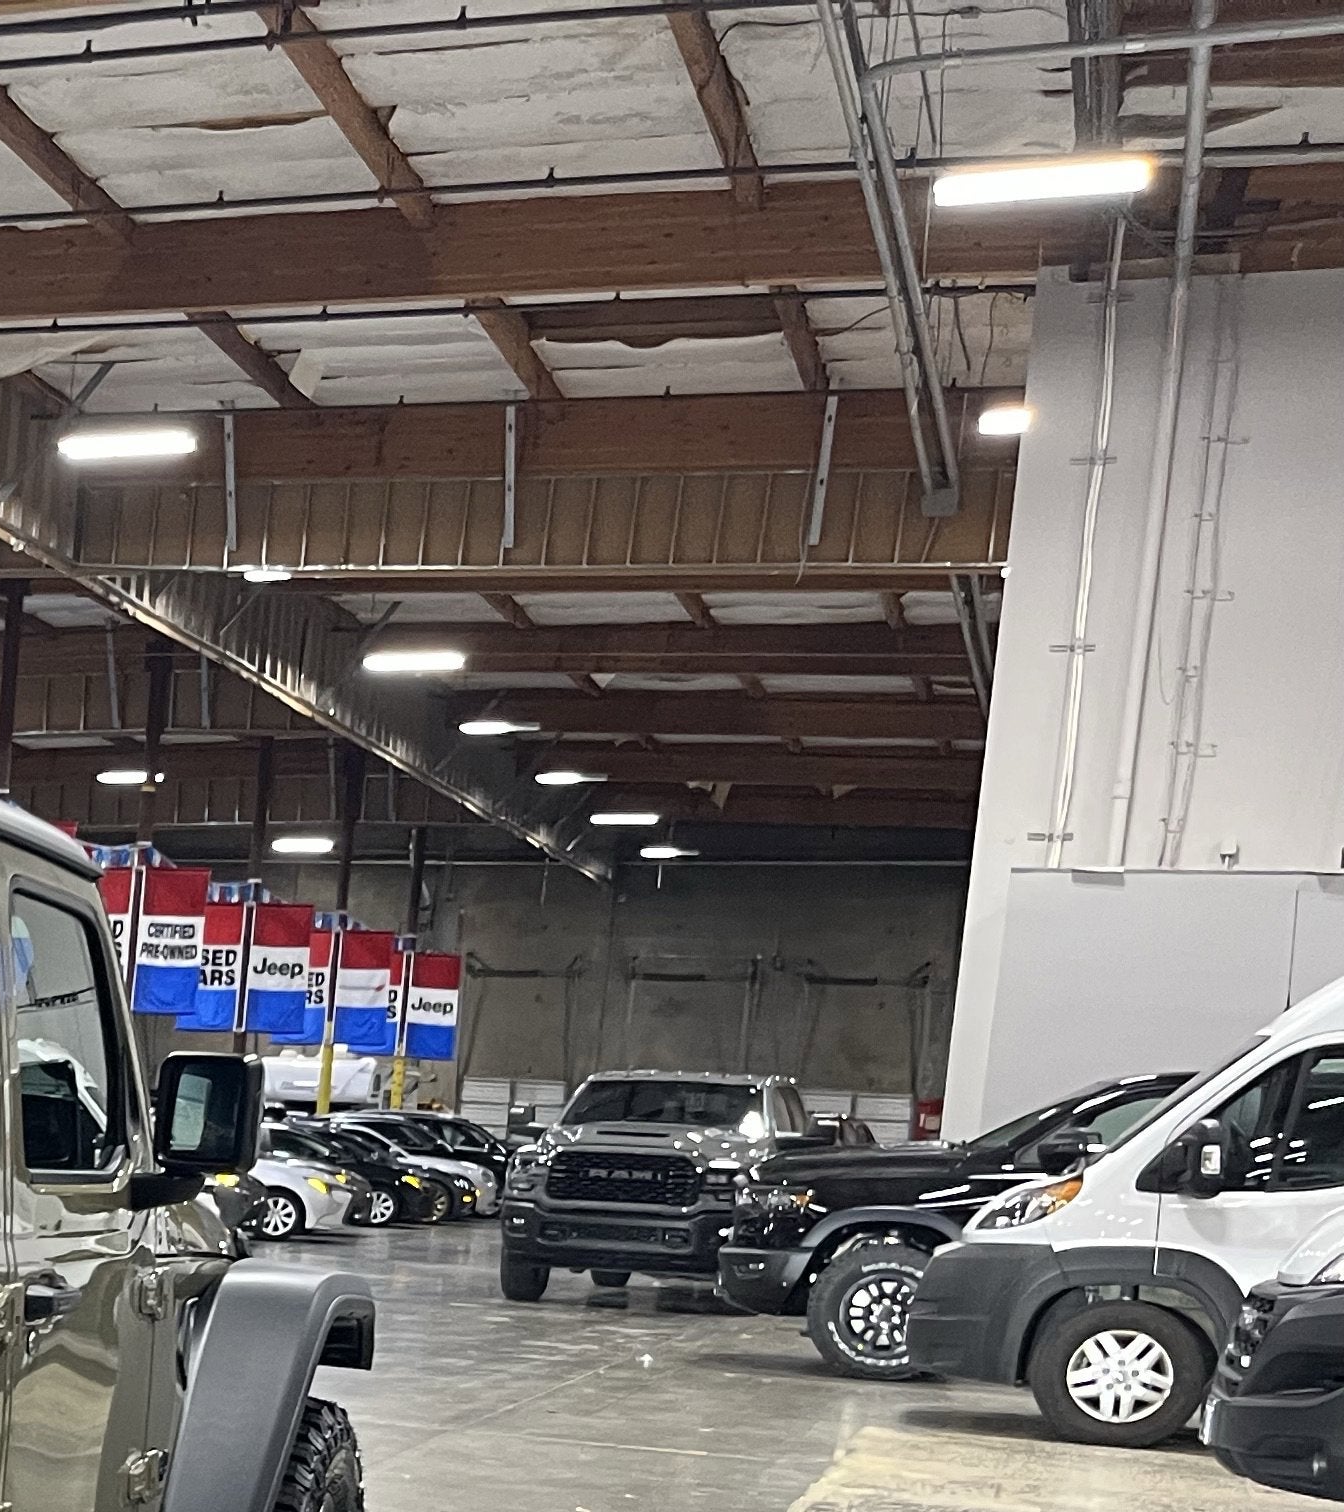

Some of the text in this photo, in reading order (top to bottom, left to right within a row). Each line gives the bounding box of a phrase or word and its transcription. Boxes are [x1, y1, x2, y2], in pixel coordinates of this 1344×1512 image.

[140, 941, 198, 960] PRE-OWNED
[201, 948, 237, 967] SED
[253, 957, 304, 979] Jeep
[411, 996, 454, 1016] Jeep
